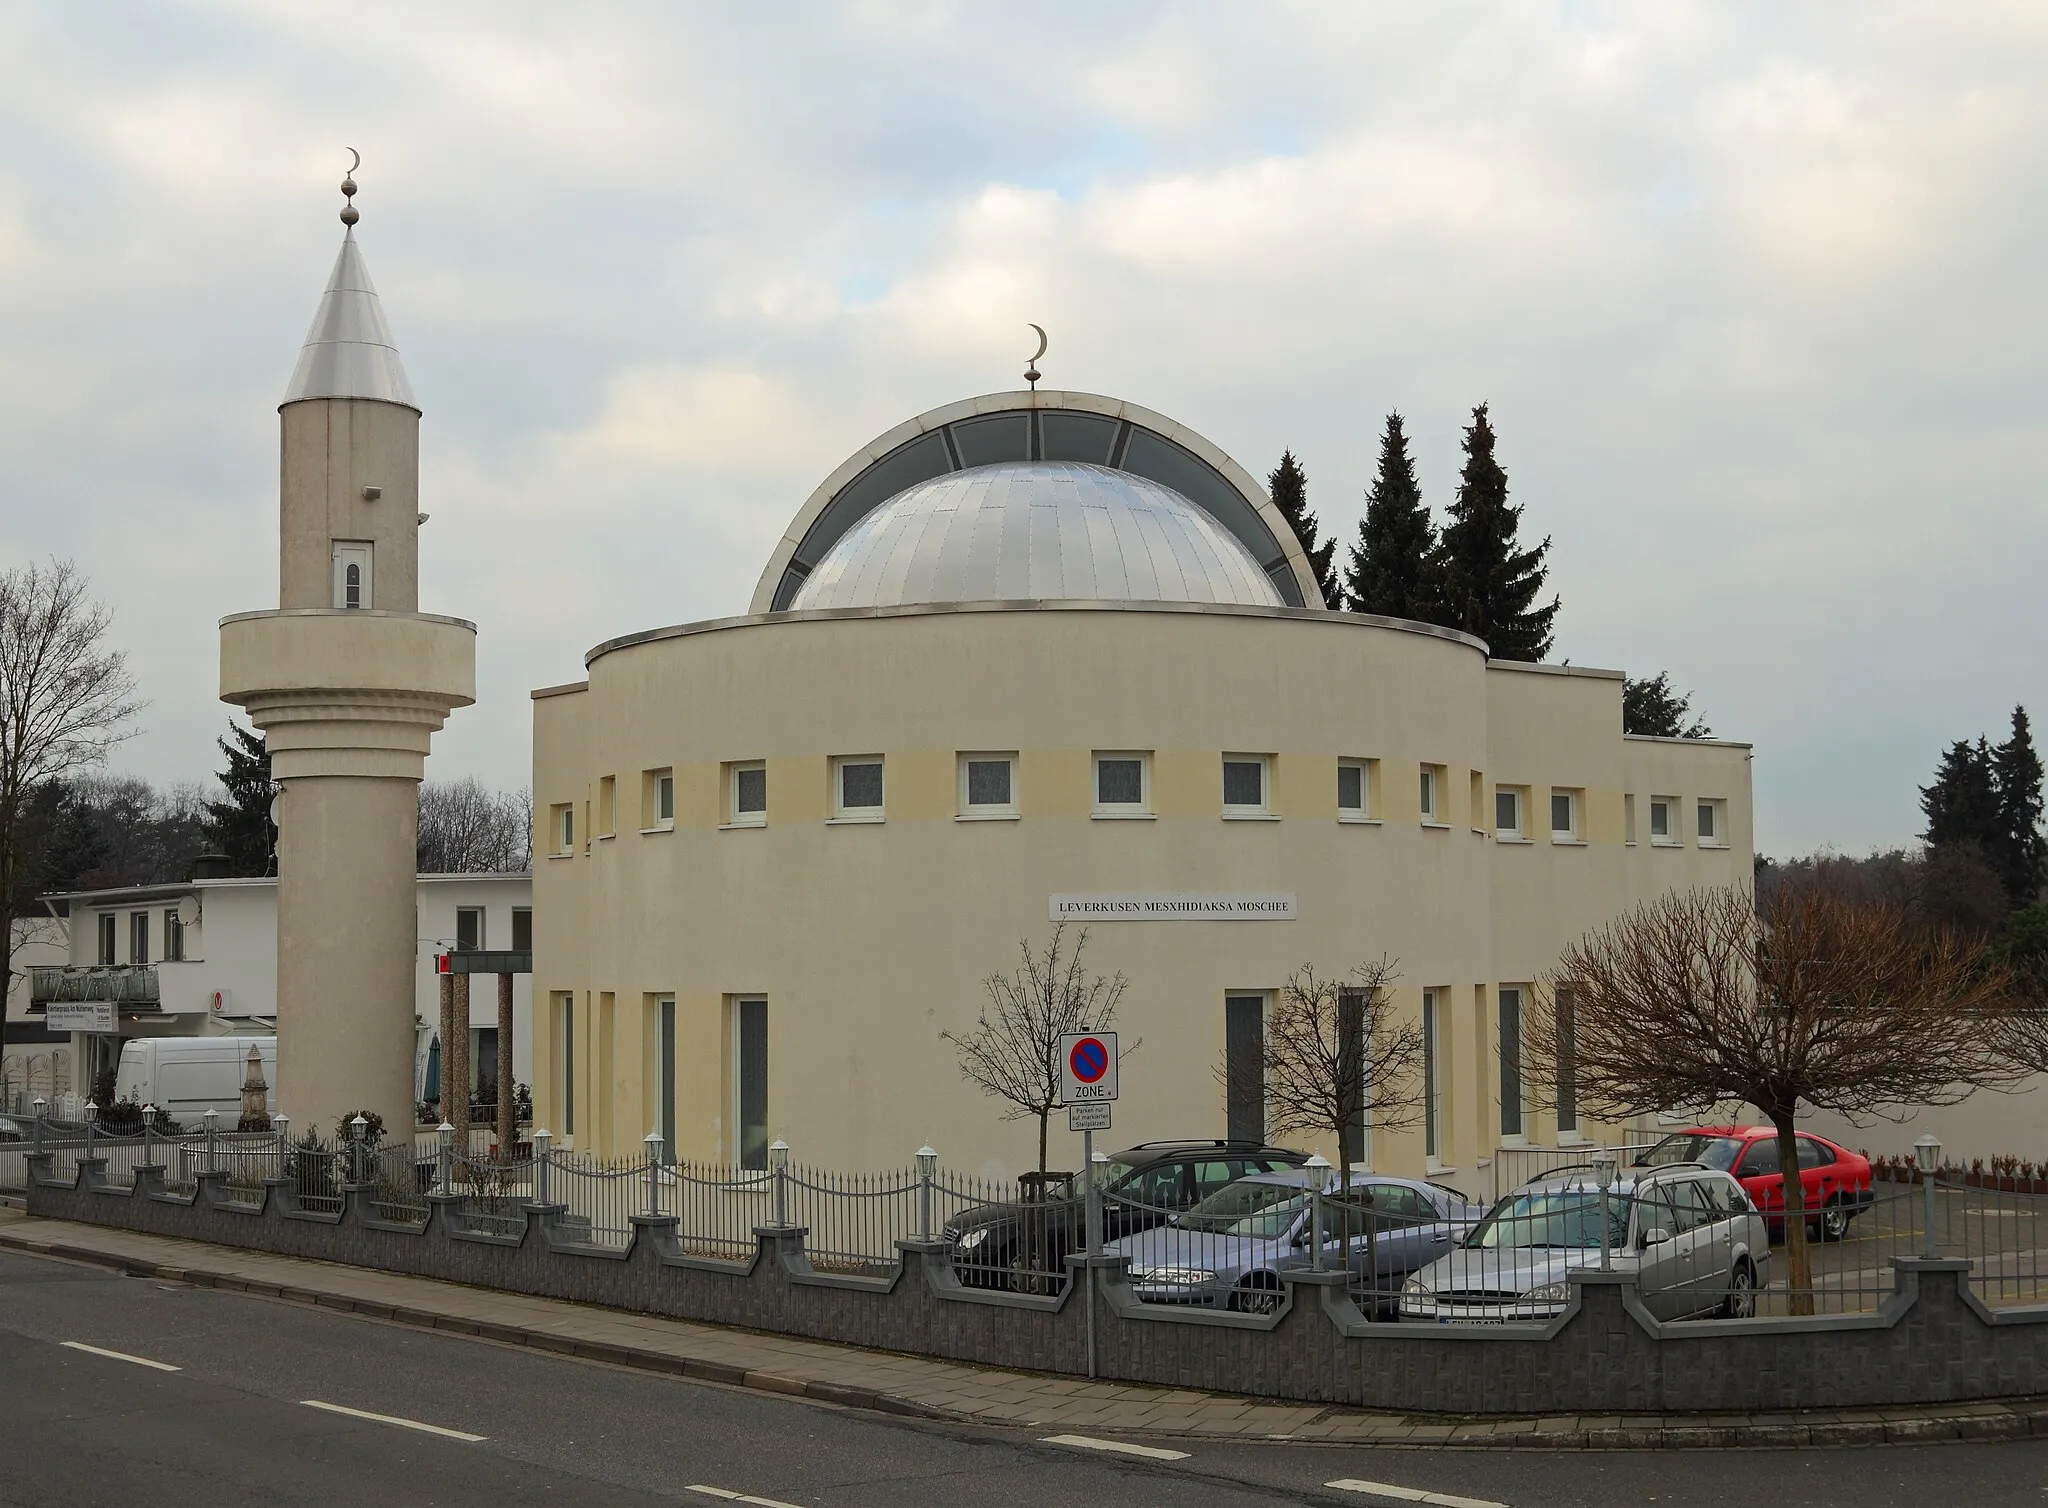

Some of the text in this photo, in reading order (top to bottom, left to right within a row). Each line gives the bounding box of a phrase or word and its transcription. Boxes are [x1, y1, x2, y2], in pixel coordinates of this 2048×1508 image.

[1059, 901, 1289, 913] LEVERKUSEN MESXHIDIAKSA MOSCHEE
[1075, 1086, 1104, 1098] ZONE
